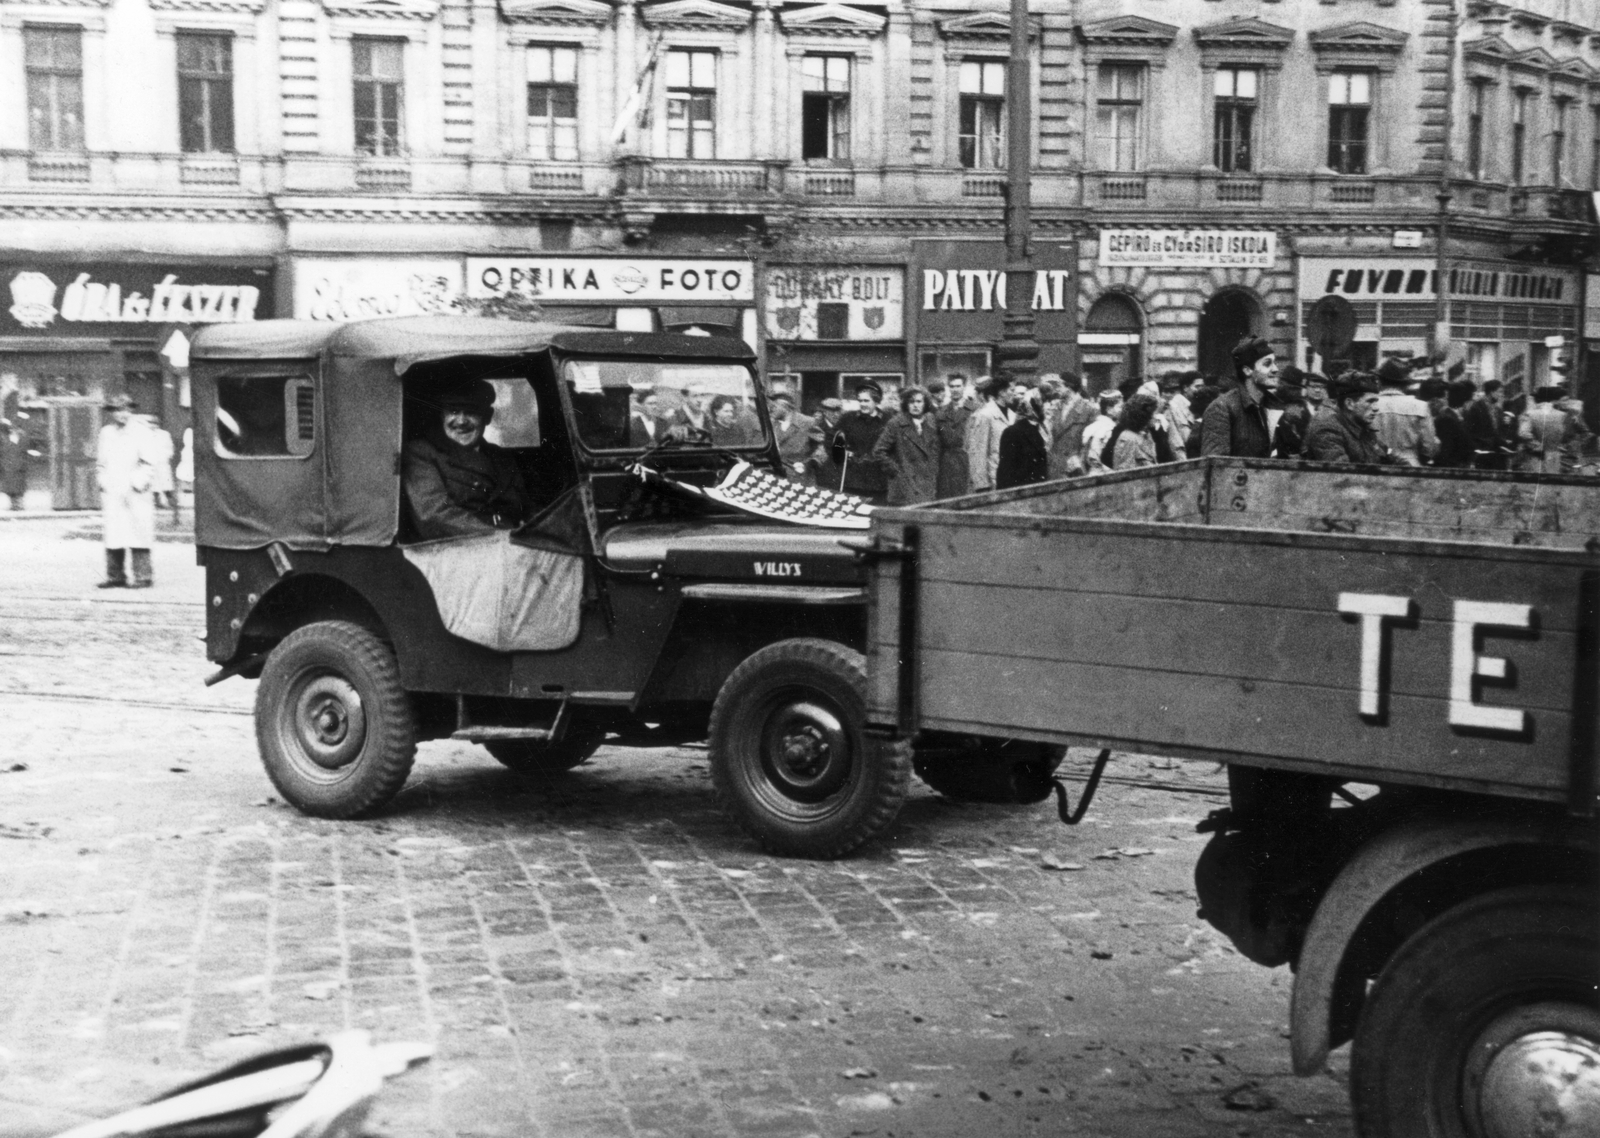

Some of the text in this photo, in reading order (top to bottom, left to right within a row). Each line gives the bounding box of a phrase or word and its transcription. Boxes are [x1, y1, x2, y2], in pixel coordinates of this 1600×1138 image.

[1227, 236, 1268, 254] ISKOLA
[481, 266, 600, 292] OPTIKA
[660, 268, 741, 291] FOTO
[852, 276, 891, 300] BOLT
[923, 269, 1068, 310] PATYAT
[61, 273, 121, 321] ÓRA
[150, 274, 259, 322] ÉKSZER
[753, 561, 801, 576] WILLYS
